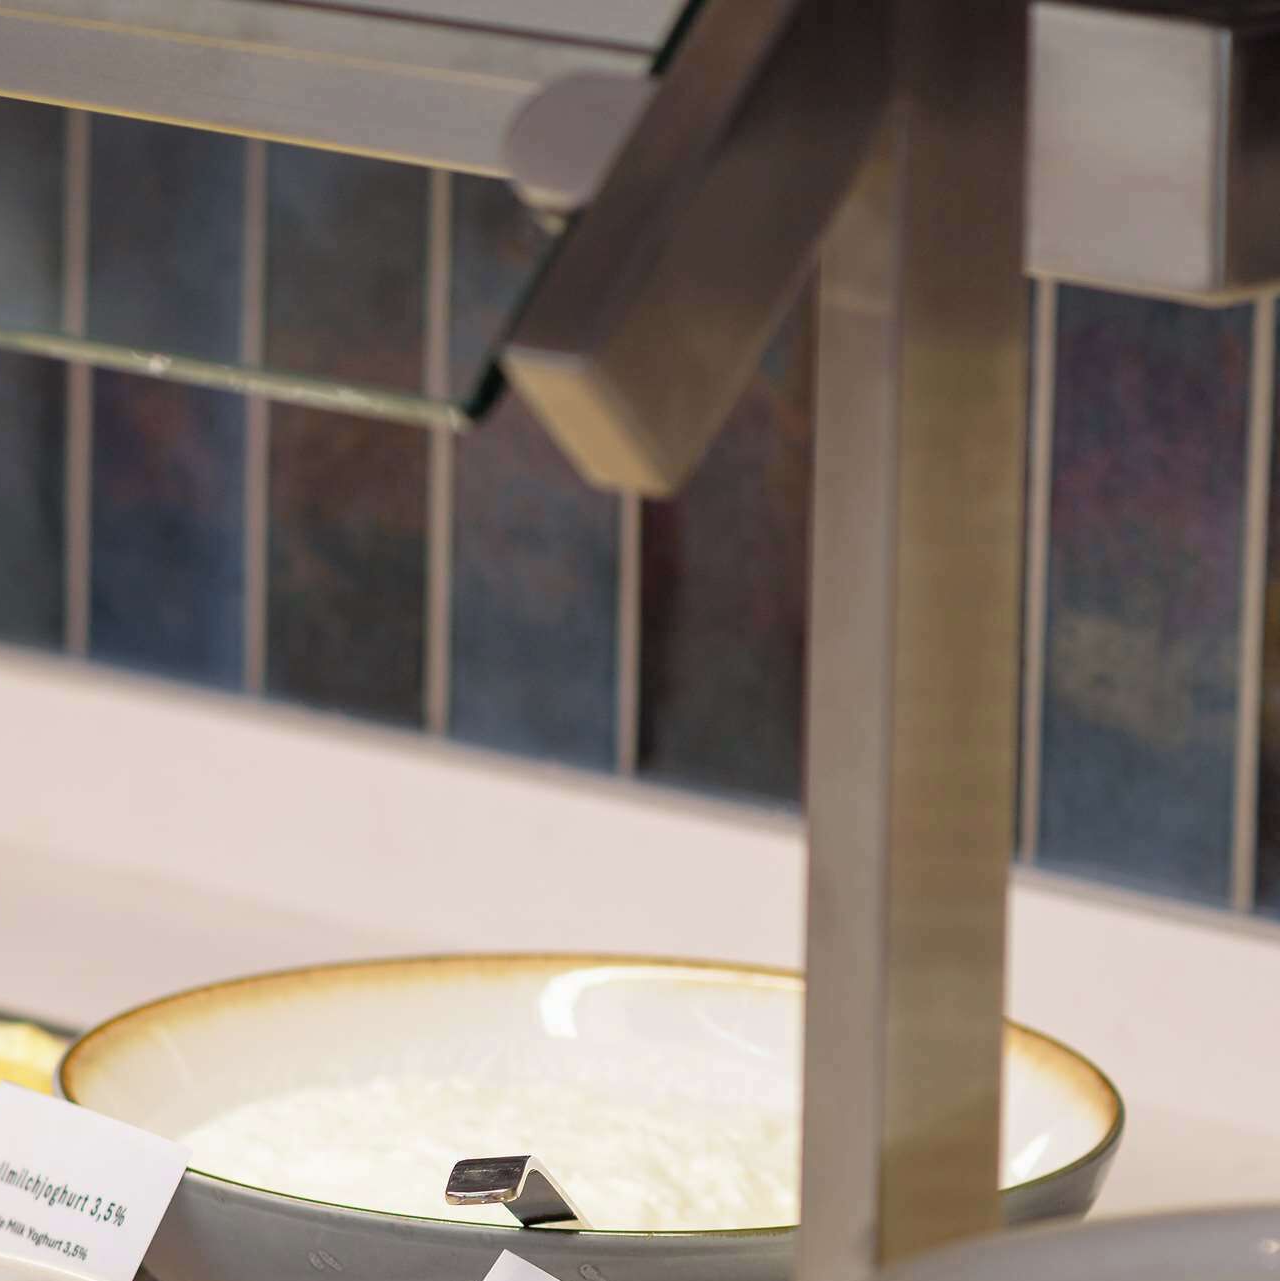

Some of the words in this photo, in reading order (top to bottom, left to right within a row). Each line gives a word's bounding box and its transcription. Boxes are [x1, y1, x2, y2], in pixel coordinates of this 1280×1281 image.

[90, 1197, 128, 1227] 3,5%
[6, 1219, 27, 1237] Milk
[27, 1227, 64, 1251] Yoghurt
[62, 1241, 89, 1262] 3,5%
